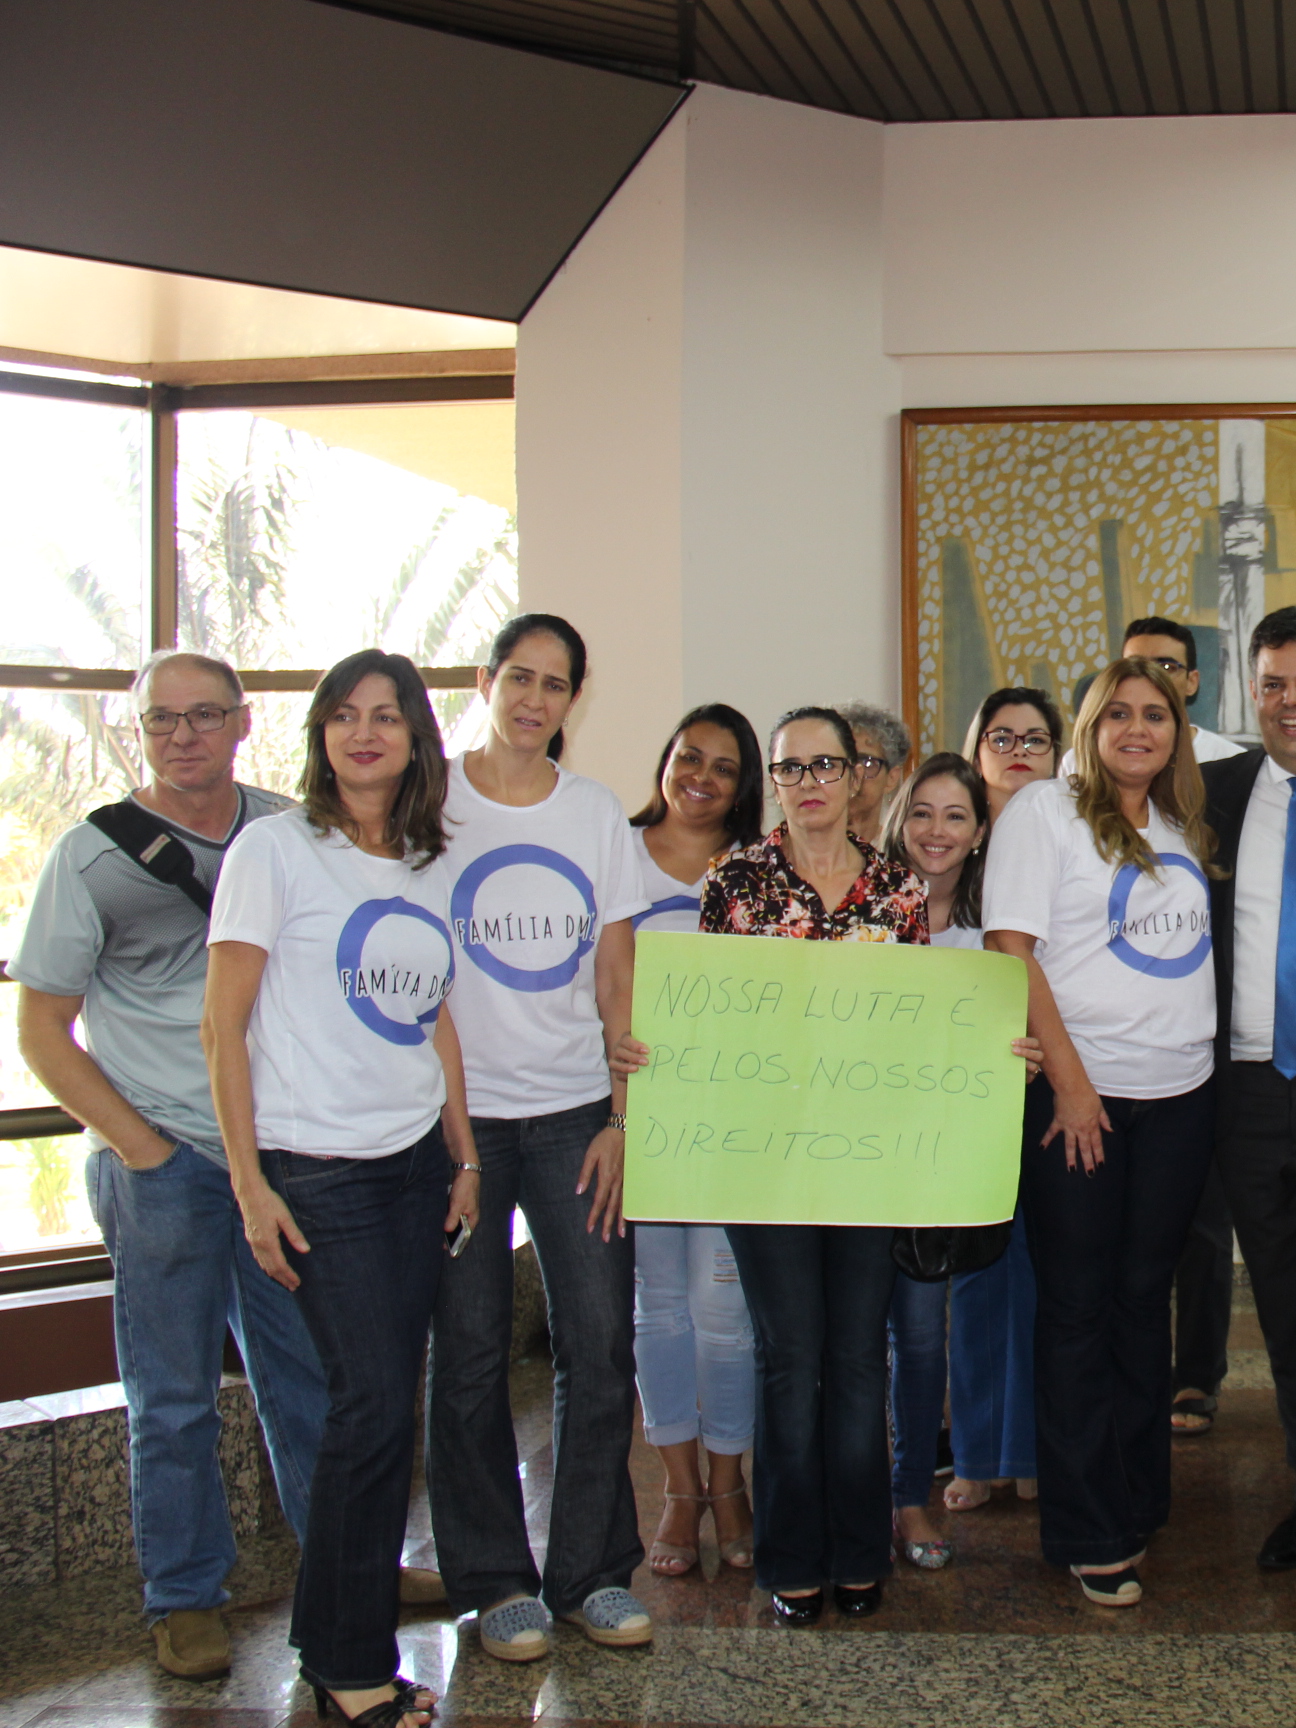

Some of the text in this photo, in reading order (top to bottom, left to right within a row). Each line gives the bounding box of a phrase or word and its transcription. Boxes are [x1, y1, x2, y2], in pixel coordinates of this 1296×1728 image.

[456, 911, 553, 944] FAMÍLIA
[1190, 910, 1211, 935] DM
[654, 973, 979, 1027] NOSSA LUTA É
[650, 1044, 995, 1099] PELOS NOSSOS
